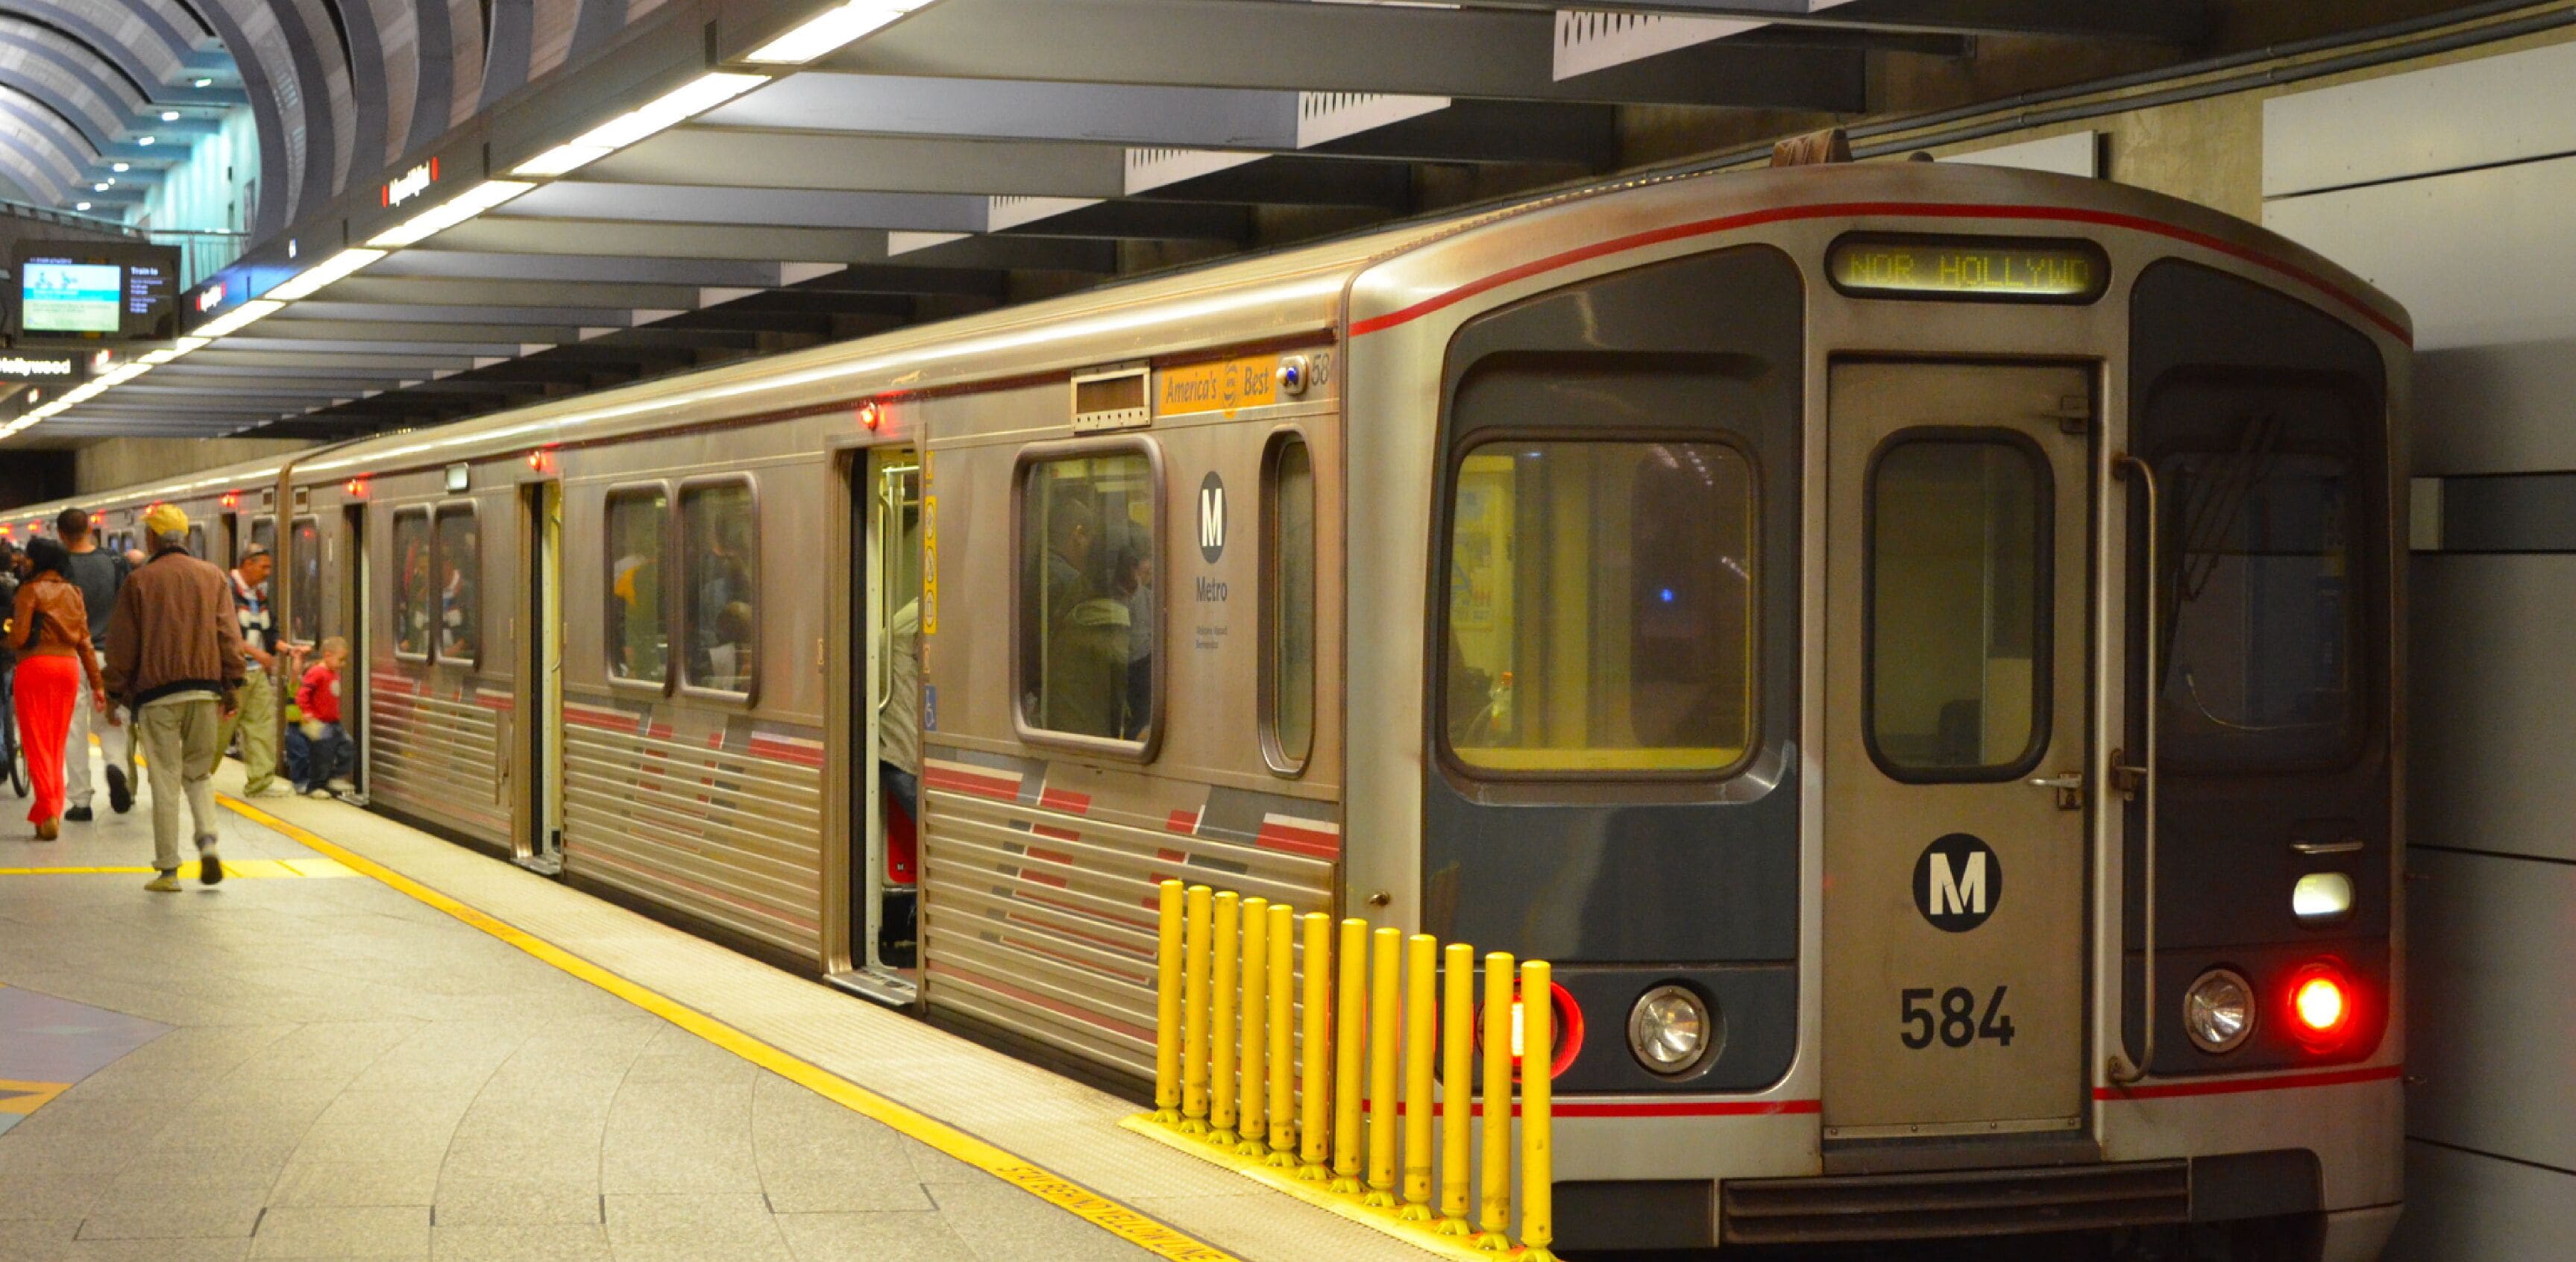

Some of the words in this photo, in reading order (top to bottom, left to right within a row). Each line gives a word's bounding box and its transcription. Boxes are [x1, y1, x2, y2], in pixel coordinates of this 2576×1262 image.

[1850, 254, 1914, 285] NOR
[1166, 370, 1218, 404] America's
[1244, 365, 1269, 396] Best
[1201, 488, 1223, 547] M
[1196, 577, 1228, 603] Metro
[1929, 850, 1987, 916] M
[1900, 985, 2014, 1050] 584
